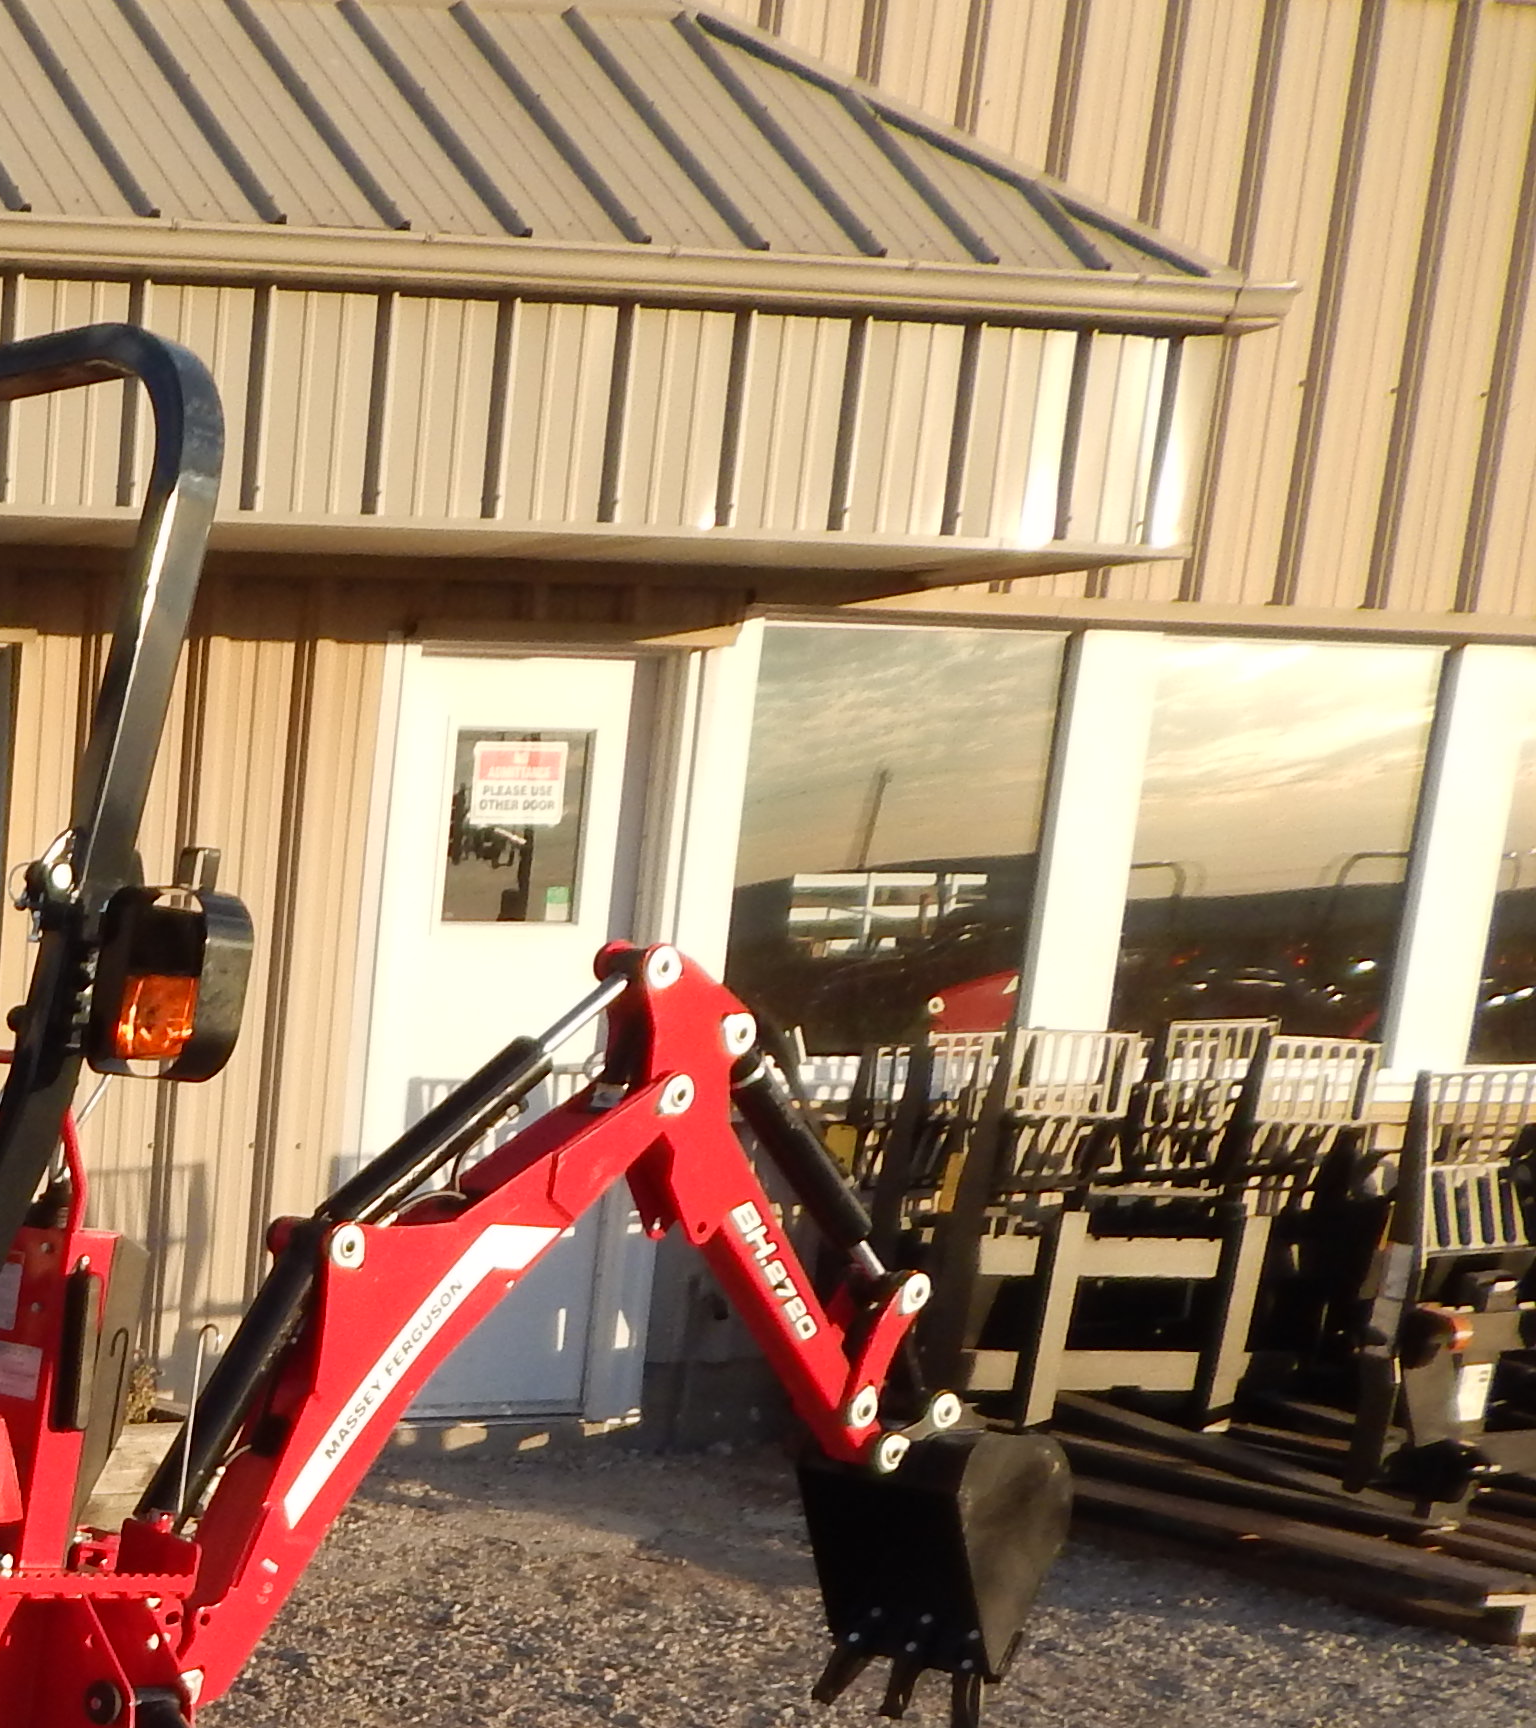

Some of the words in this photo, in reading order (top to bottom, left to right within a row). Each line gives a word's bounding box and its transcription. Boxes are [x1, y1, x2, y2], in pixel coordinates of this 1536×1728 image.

[479, 799, 519, 811] OTHER
[522, 799, 556, 812] DOOR
[482, 785, 528, 796] PLEASE
[530, 786, 553, 797] USE
[730, 1200, 818, 1341] BH.2720
[324, 1379, 382, 1459] MASSEY
[384, 1279, 463, 1376] FERGUSON
